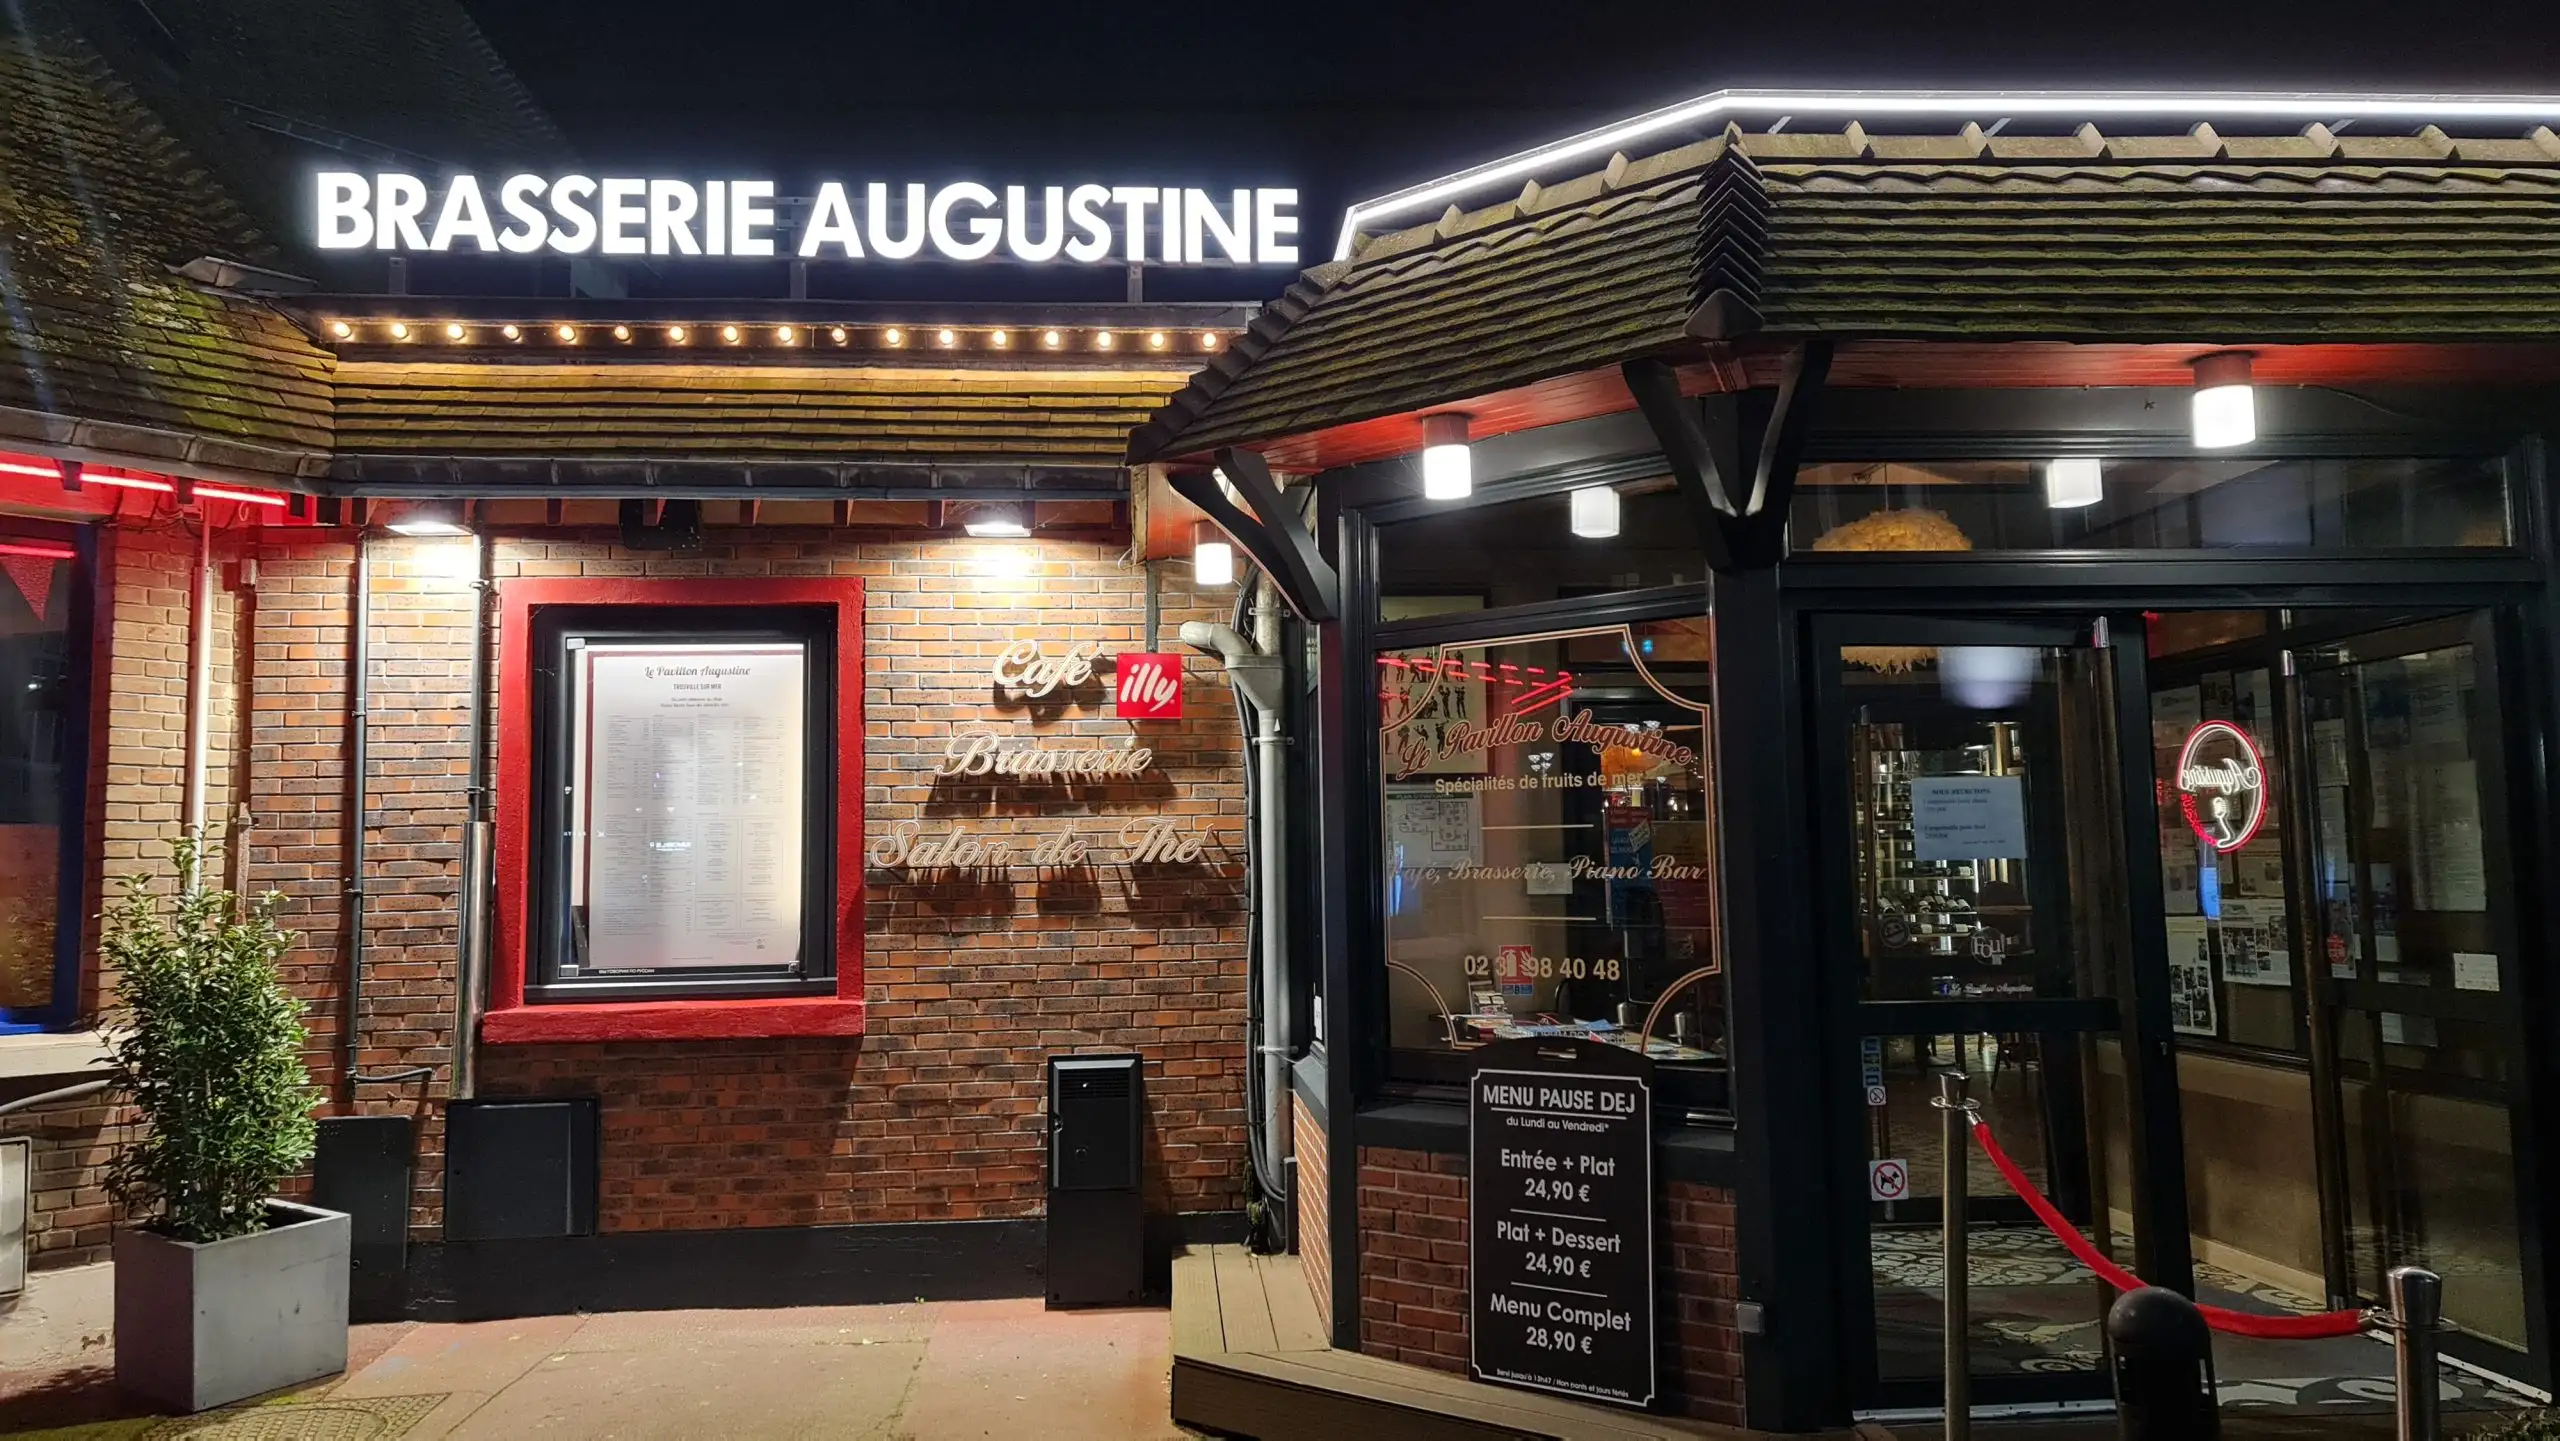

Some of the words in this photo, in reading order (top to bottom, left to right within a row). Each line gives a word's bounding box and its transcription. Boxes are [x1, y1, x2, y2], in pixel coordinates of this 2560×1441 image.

[315, 171, 775, 258] BRASSERIE
[797, 180, 1300, 264] AUGUSTINE
[657, 665, 698, 677] Pavillon
[700, 665, 751, 679] Augustine
[992, 638, 1103, 700] Café
[1120, 662, 1178, 712] illy
[934, 730, 1153, 778] Brasserie
[1396, 738, 1432, 780] Le
[1441, 713, 1543, 760] Pavillon
[1552, 708, 1692, 765] Augustine
[1435, 777, 1516, 795] Spécialités
[1520, 774, 1538, 789] de
[1542, 770, 1583, 788] fruits
[1588, 771, 1606, 787] de
[1612, 771, 1643, 786] mer
[869, 819, 1012, 869] Salon
[1031, 825, 1088, 866] de
[1111, 816, 1214, 865] Thé
[1567, 854, 1644, 881] Piano
[1646, 854, 1709, 880] Bar
[1464, 955, 1490, 976] 02
[1528, 957, 1553, 978] 98
[1559, 957, 1586, 980] 40
[1592, 959, 1621, 981] 48
[1483, 1084, 1534, 1107] MENU
[1540, 1087, 1593, 1111] PAUSE
[1601, 1091, 1636, 1114] DEJ
[1506, 1117, 1518, 1127] du
[1521, 1117, 1545, 1128] Lundi
[1547, 1121, 1559, 1129] au
[1501, 1148, 1557, 1171] Entrée
[1563, 1159, 1574, 1170] +
[1580, 1155, 1615, 1177] Plat
[1525, 1178, 1573, 1202] 24,90
[1579, 1185, 1590, 1202] €
[1497, 1221, 1530, 1242] Plat
[1536, 1230, 1546, 1241] +
[1552, 1227, 1621, 1254] Dessert
[1526, 1251, 1574, 1278] 24,90
[1580, 1260, 1591, 1278] €
[1490, 1293, 1541, 1319] Menu
[1547, 1301, 1631, 1332] Complet
[1526, 1327, 1575, 1352] 28,90
[1581, 1337, 1593, 1354] €
